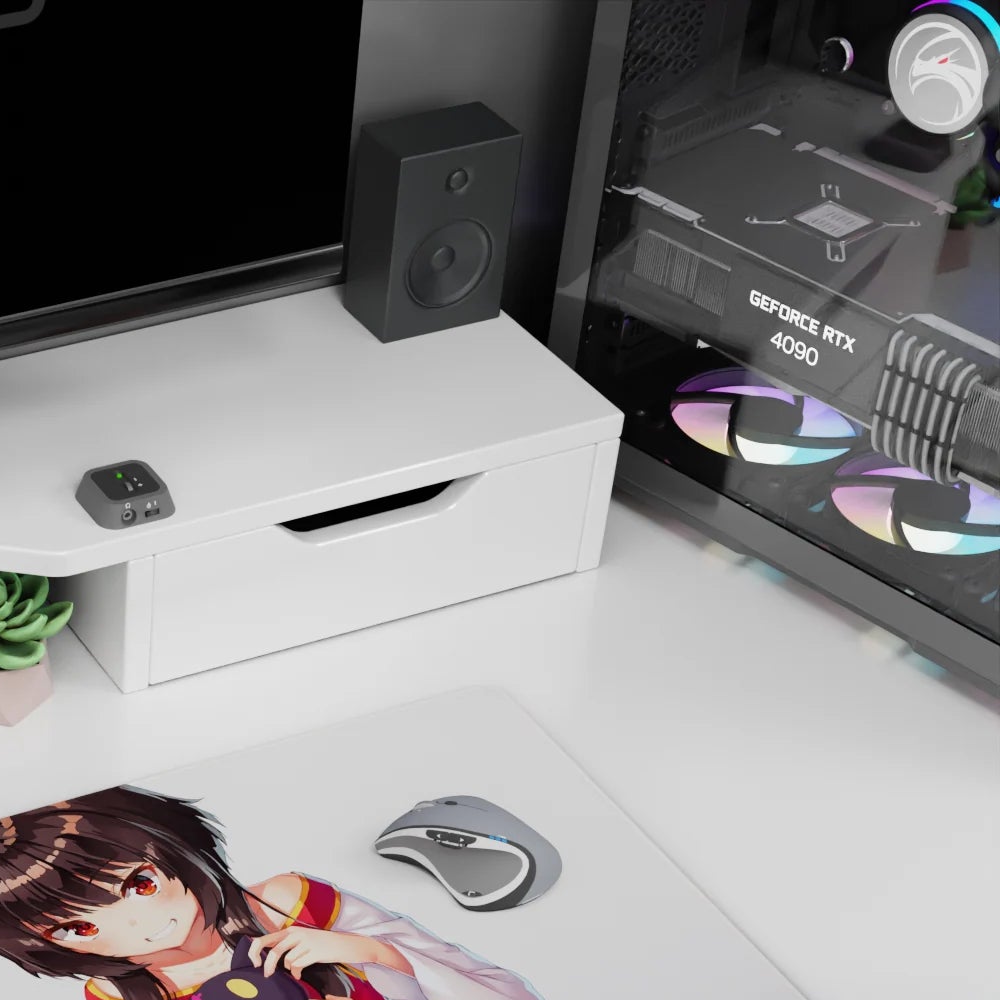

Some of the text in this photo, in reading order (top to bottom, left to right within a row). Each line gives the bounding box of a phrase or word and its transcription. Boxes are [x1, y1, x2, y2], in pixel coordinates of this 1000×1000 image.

[749, 289, 857, 354] GEFORCE RTX
[770, 331, 819, 367] 4090
